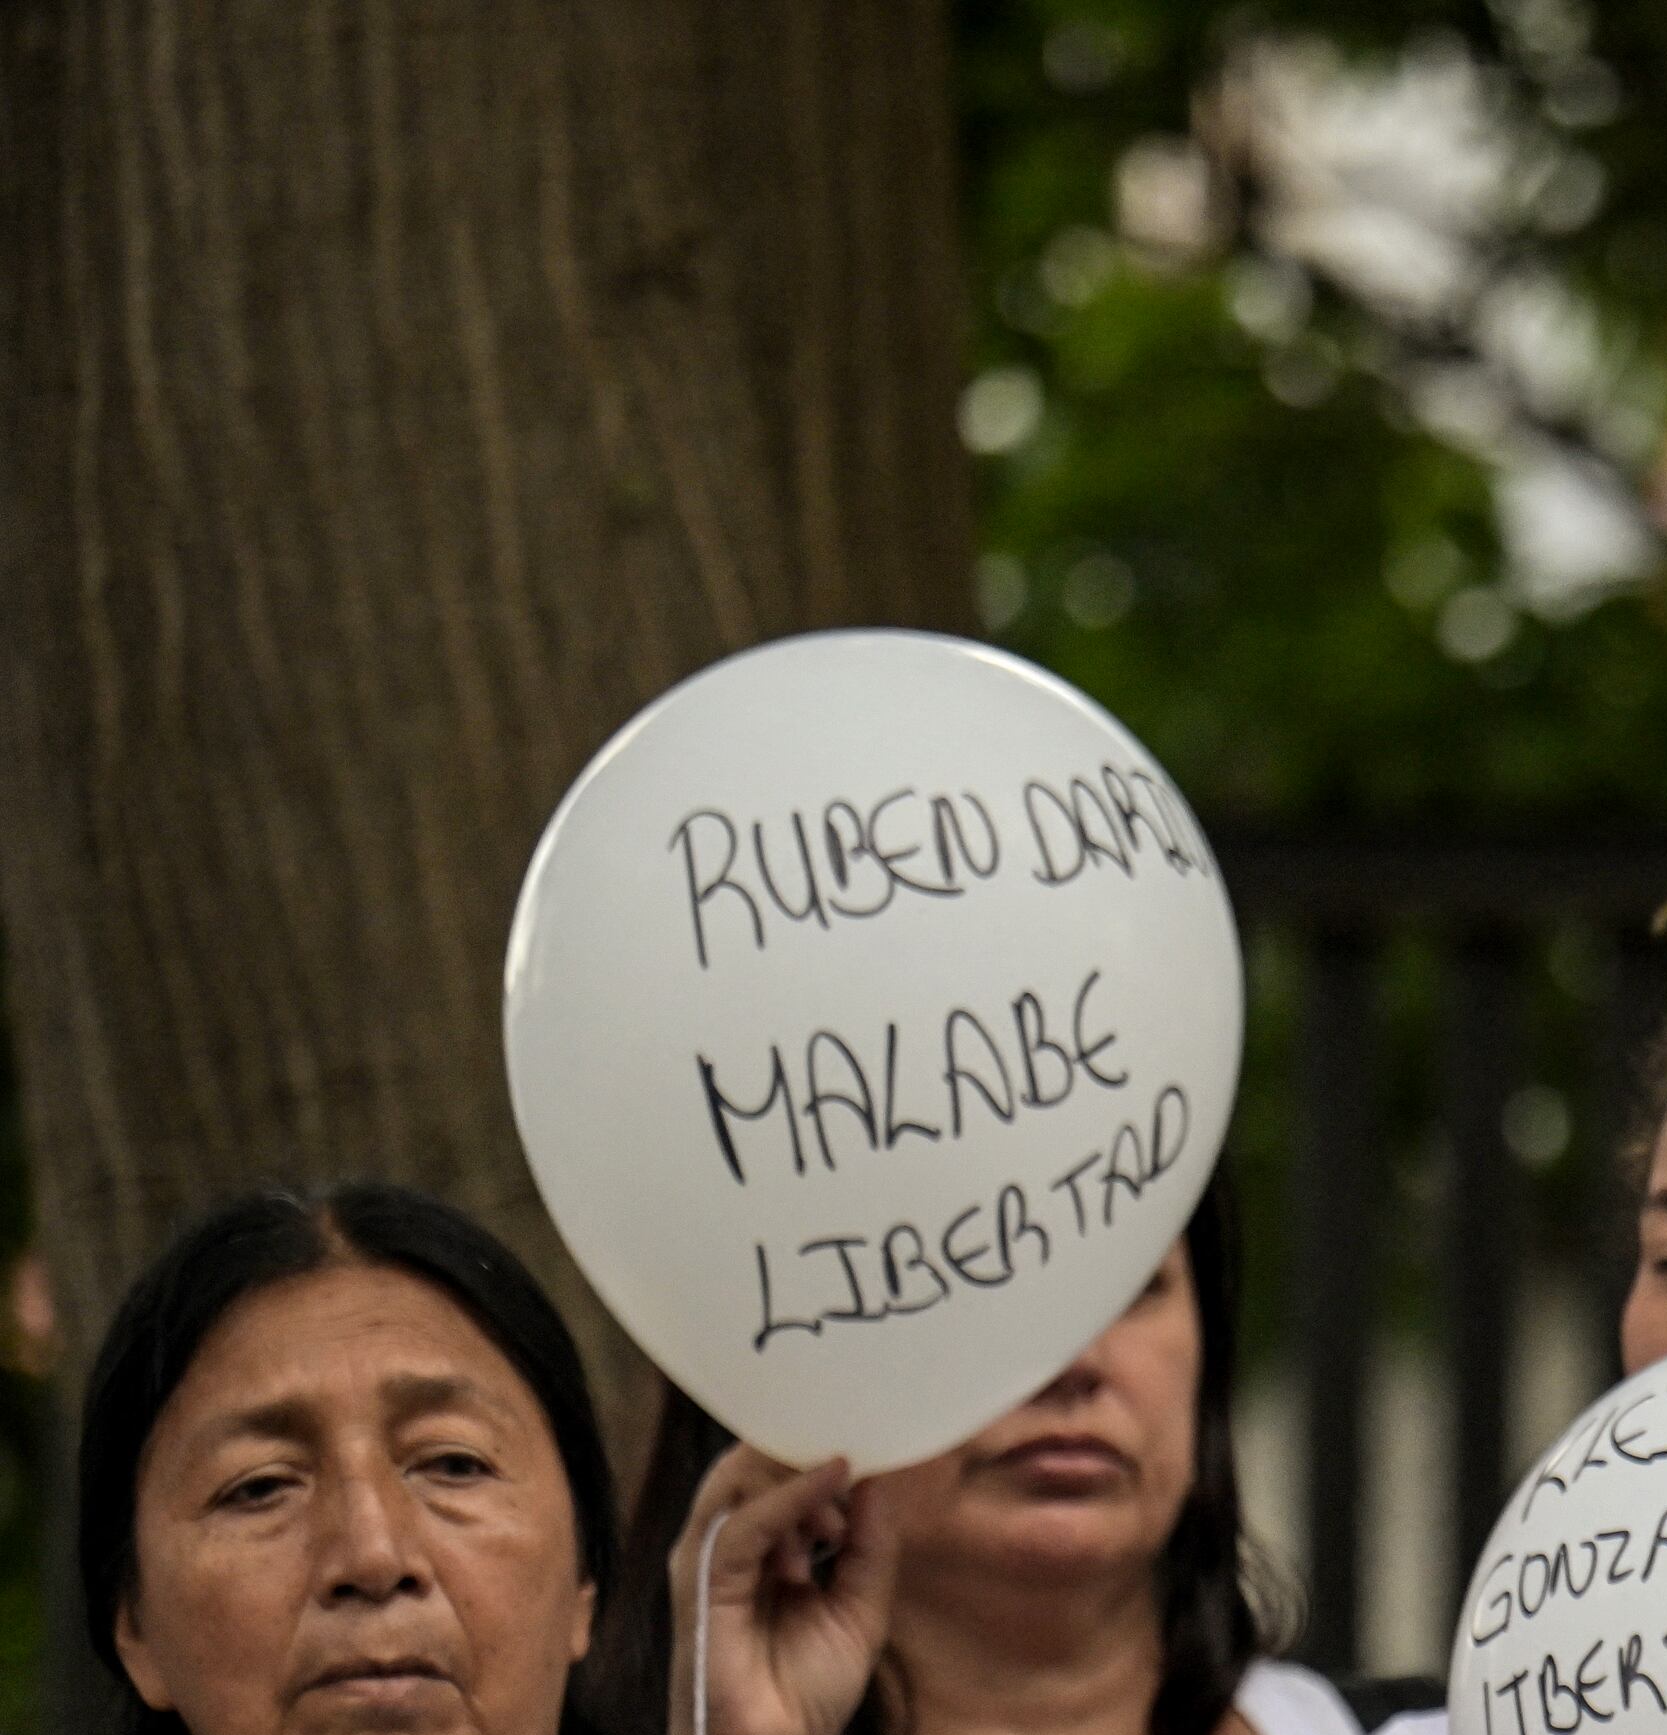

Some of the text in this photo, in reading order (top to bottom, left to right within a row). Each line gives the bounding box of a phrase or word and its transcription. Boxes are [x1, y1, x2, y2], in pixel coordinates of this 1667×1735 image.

[668, 788, 1002, 968] RUBEN
[694, 971, 1128, 1185] MALABE
[752, 1084, 1189, 1352] LIBERTAD
